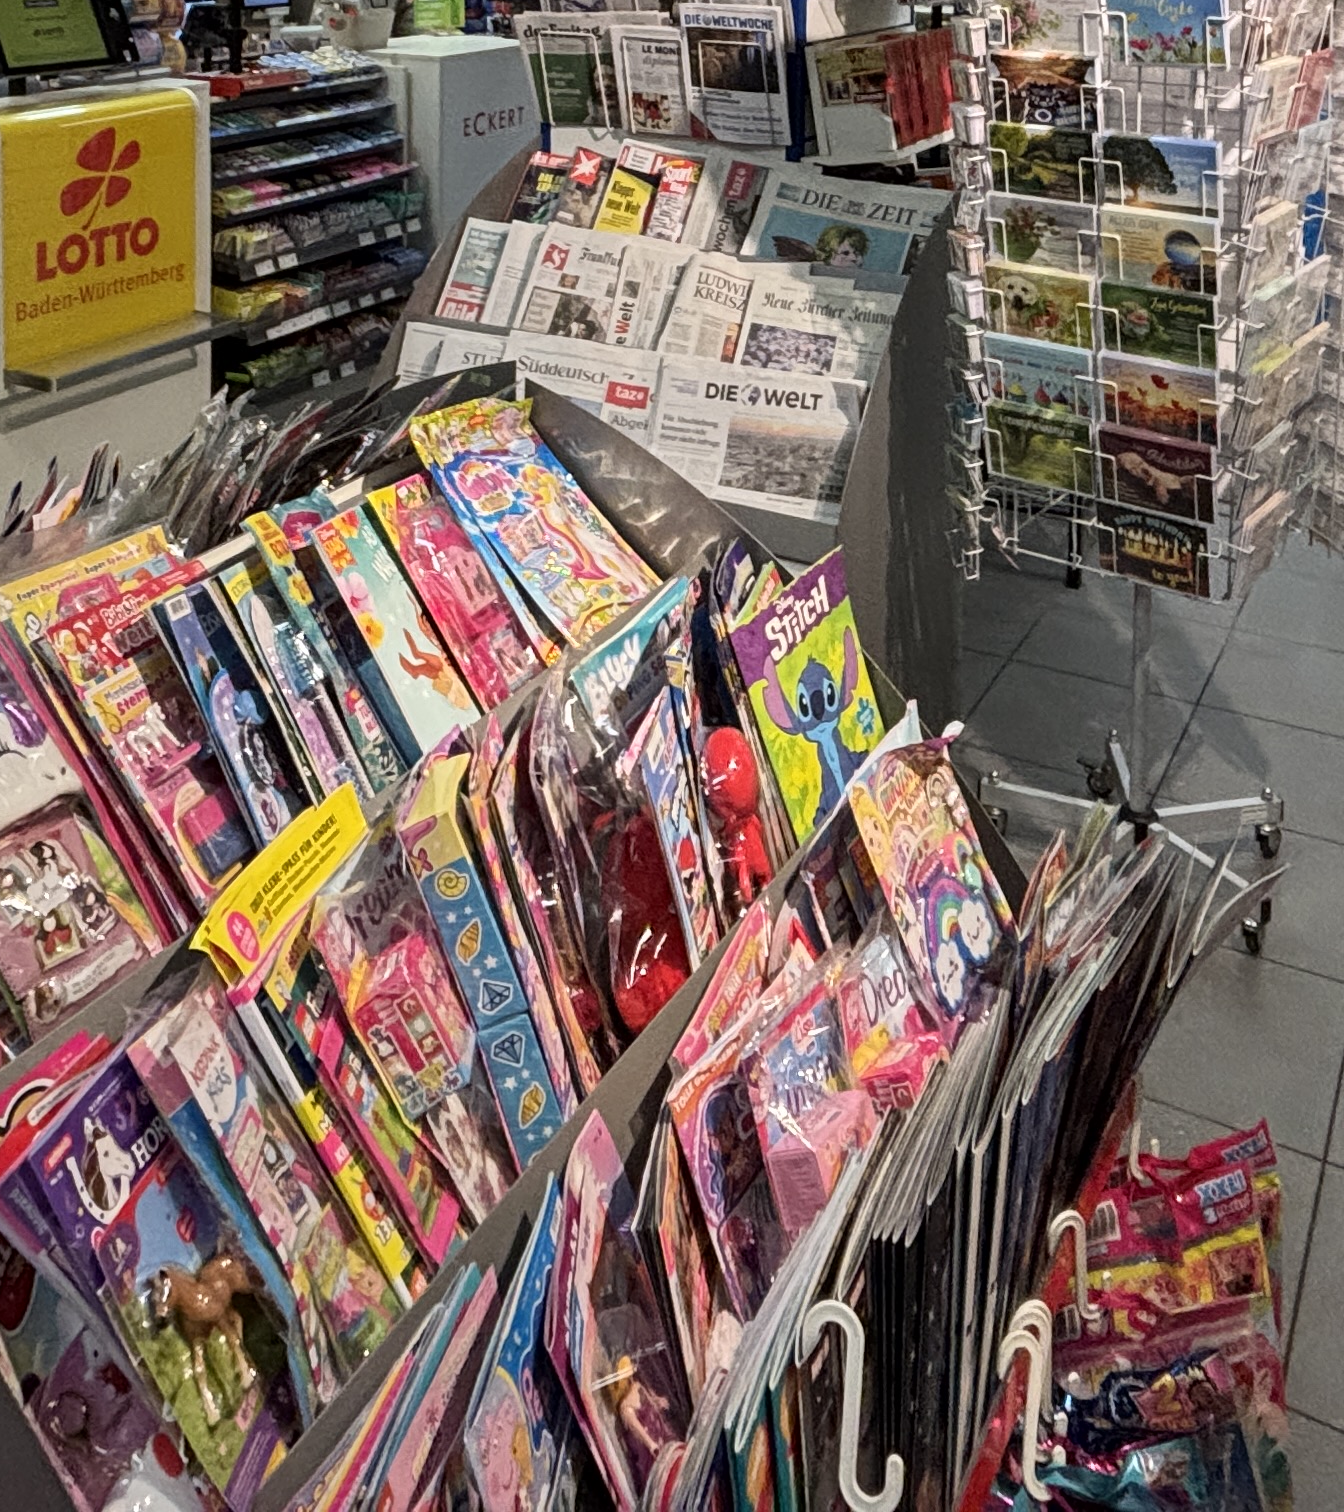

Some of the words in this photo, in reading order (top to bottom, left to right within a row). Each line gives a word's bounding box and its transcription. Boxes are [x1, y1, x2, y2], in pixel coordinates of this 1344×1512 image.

[684, 14, 702, 26] DIE
[711, 15, 774, 31] WELTWOCHE
[462, 107, 525, 137] ECKERT
[802, 188, 843, 212] DIE
[866, 201, 919, 227] ZEIT
[36, 217, 160, 283] LOTTO
[15, 262, 186, 322] Baden-Württemberg
[762, 292, 793, 311] Neue
[797, 295, 846, 320] Zürcher
[614, 300, 637, 335] Welt
[705, 382, 740, 402] DIE
[297, 837, 315, 857] FÜR
